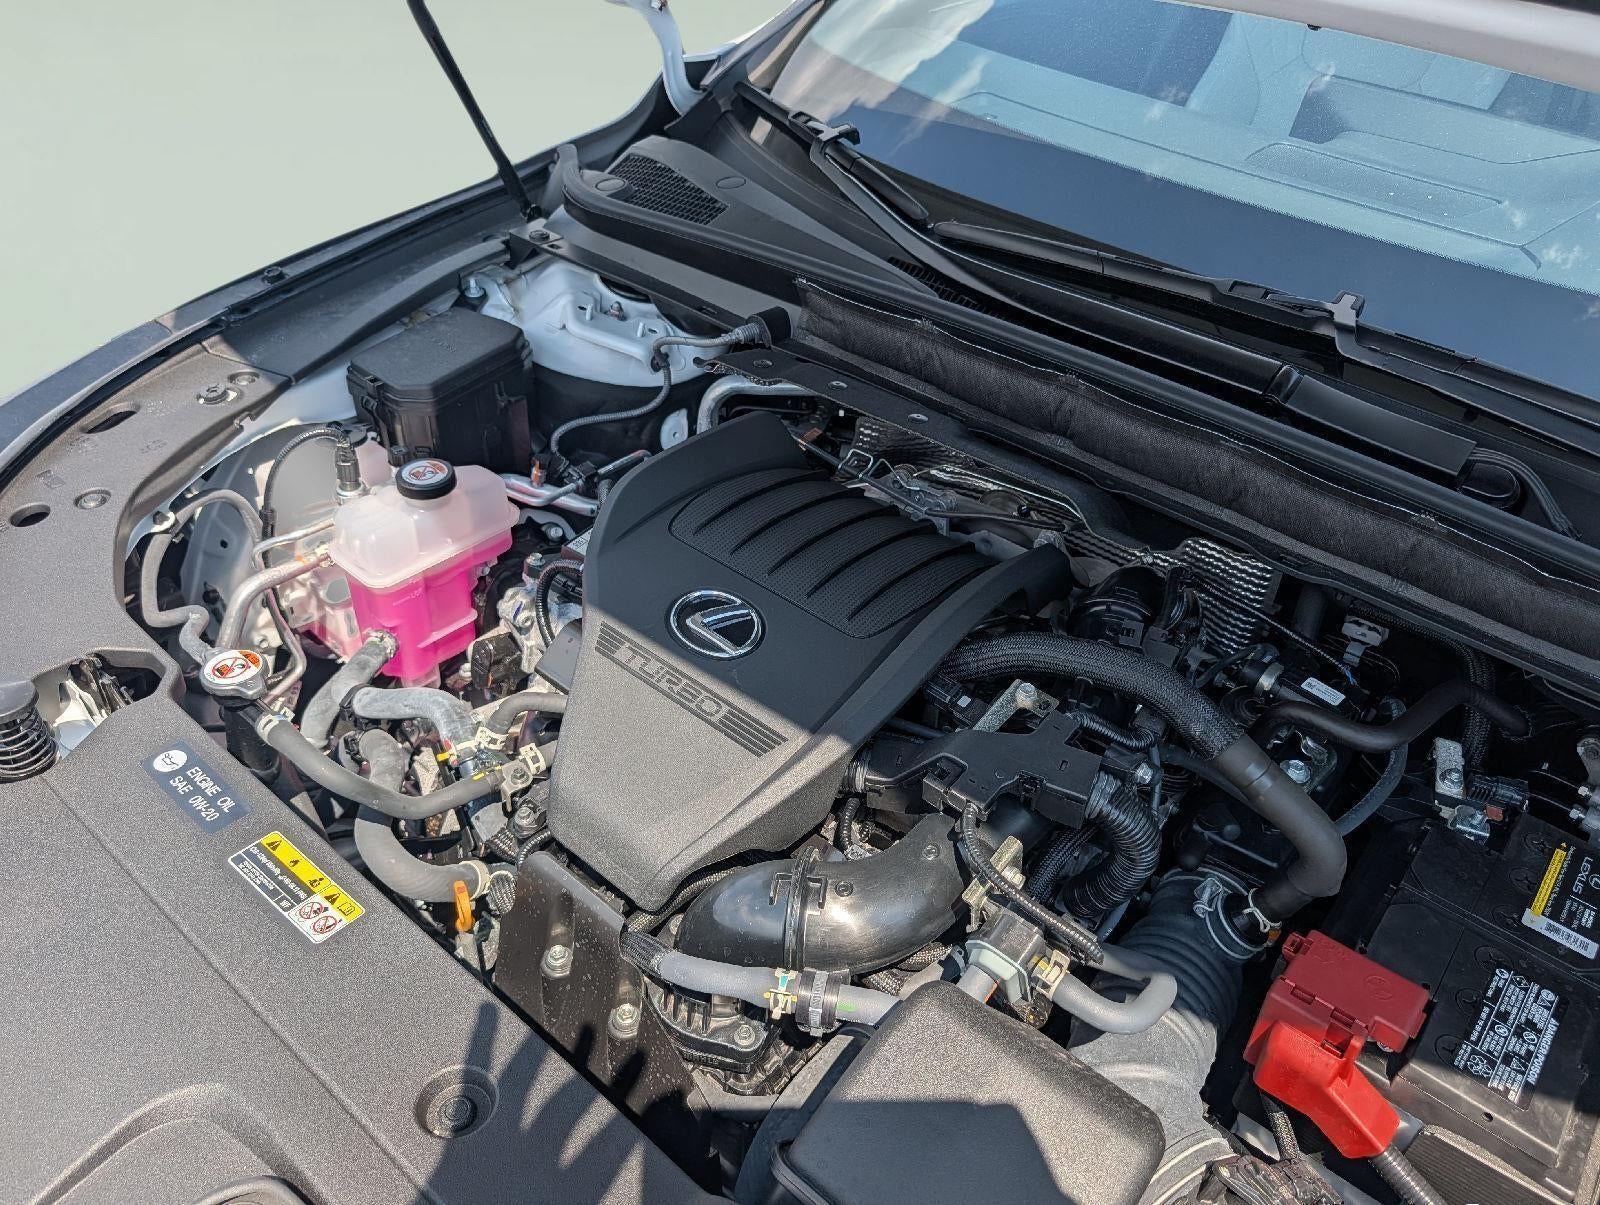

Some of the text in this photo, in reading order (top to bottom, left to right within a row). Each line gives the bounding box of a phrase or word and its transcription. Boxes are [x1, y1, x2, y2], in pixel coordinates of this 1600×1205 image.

[624, 644, 724, 718] TURBO
[169, 775, 221, 822] SAE 0W-20
[186, 766, 236, 813] ENGINE OIL
[1571, 856, 1595, 895] LEXUS
